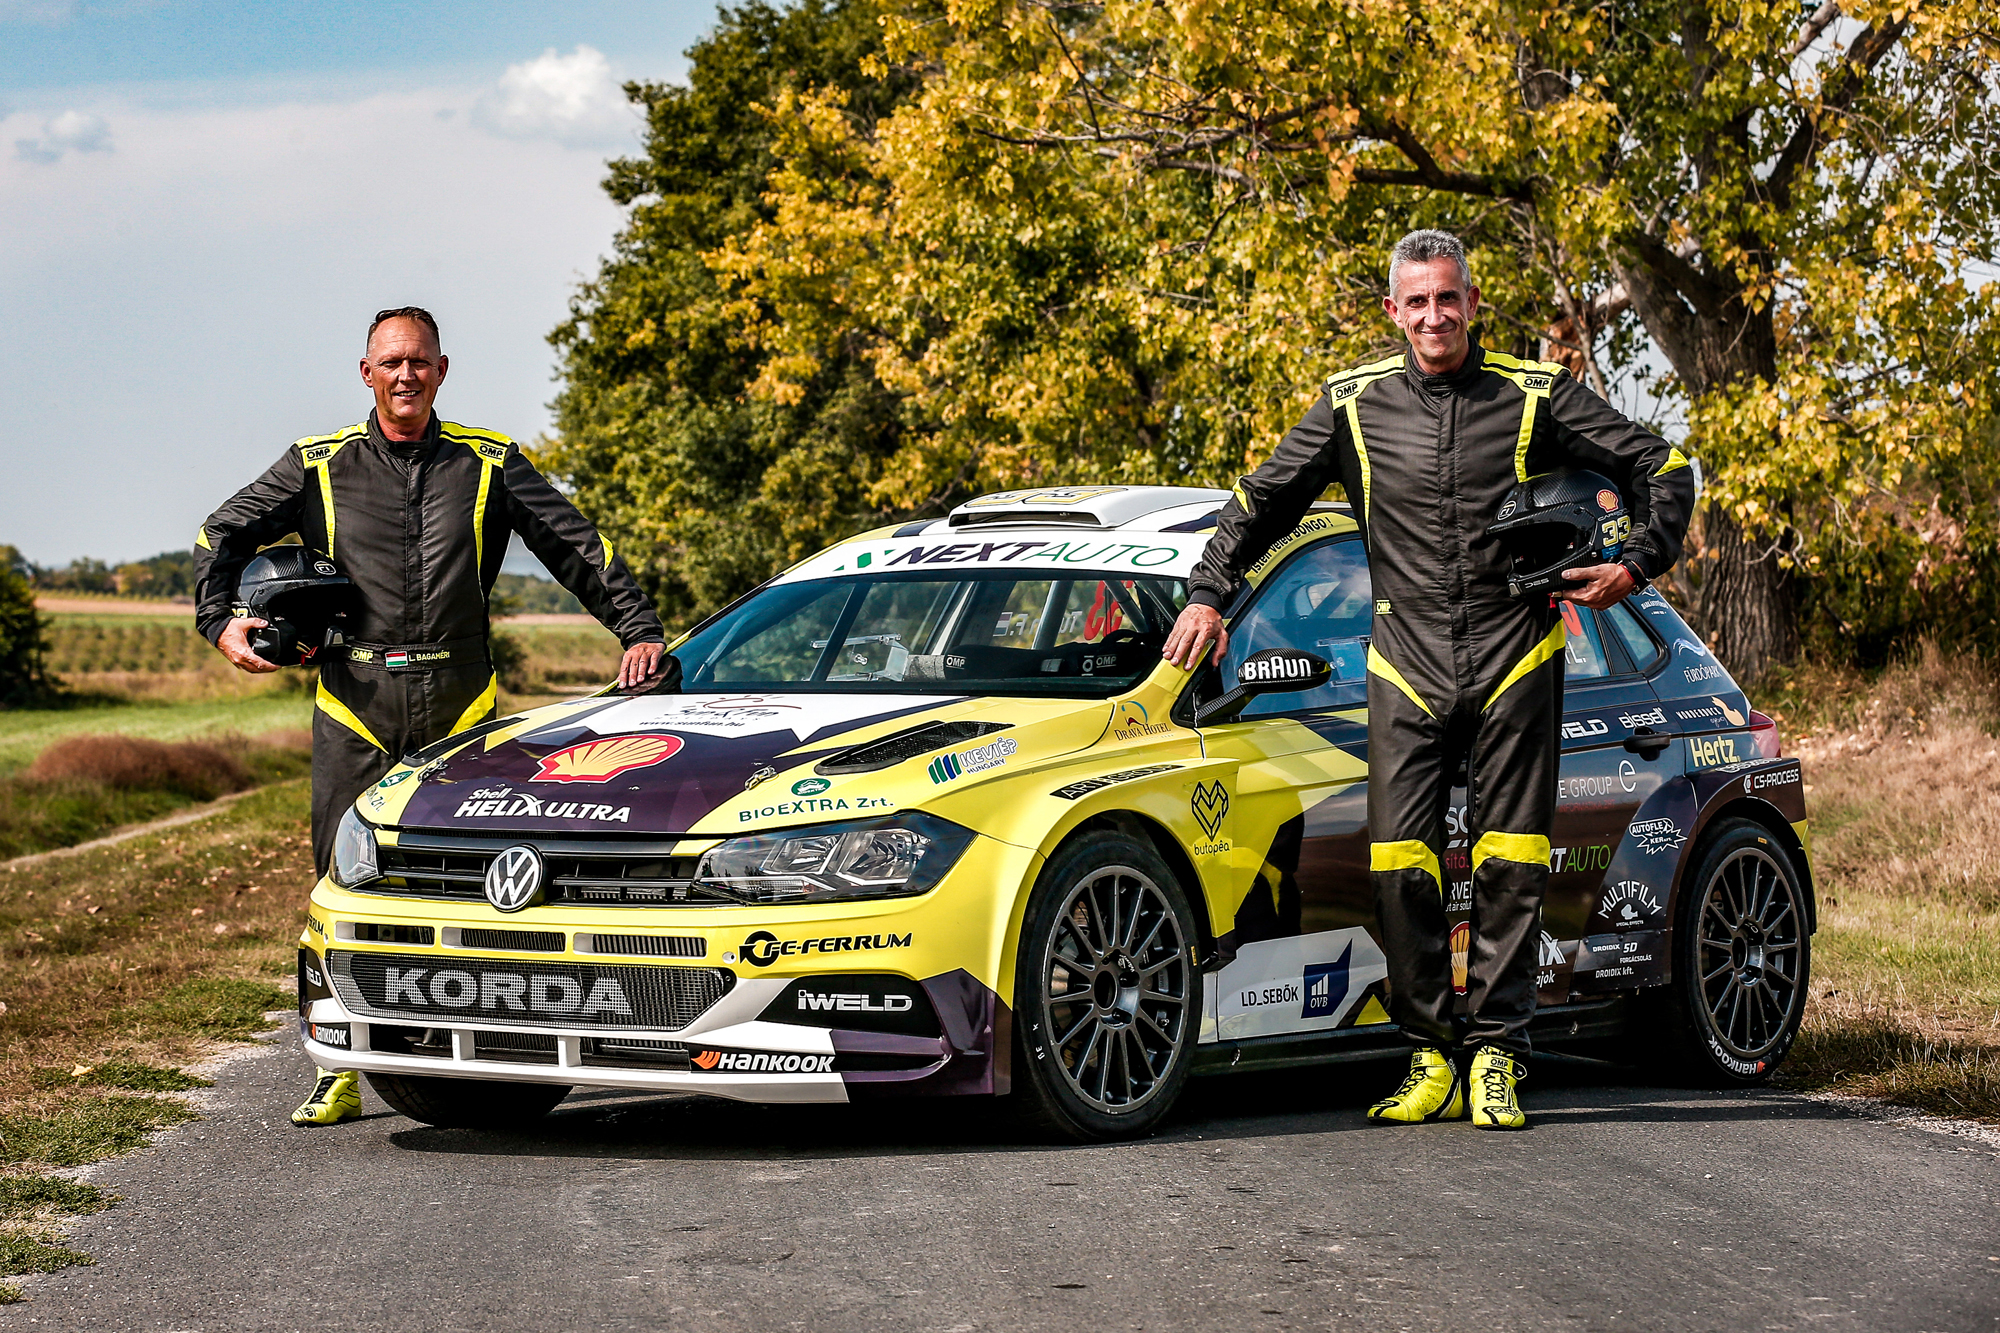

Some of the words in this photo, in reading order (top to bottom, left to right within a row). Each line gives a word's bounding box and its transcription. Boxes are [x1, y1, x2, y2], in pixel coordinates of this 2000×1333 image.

[1523, 378, 1549, 388] OMP
[1335, 383, 1358, 398] OMP
[306, 448, 331, 460] OMP
[479, 445, 504, 457] OMP
[1292, 517, 1327, 539] BONGO
[1601, 514, 1632, 548] 33
[351, 650, 374, 662] OMP
[946, 656, 967, 667] OMP
[1095, 656, 1117, 667] OMP
[1143, 722, 1172, 735] HOTEL
[966, 758, 1006, 774] HUNGARY
[1754, 768, 1799, 789] CS-PROCESS
[469, 787, 513, 801] Shell
[1569, 776, 1612, 798] GROUP
[453, 799, 545, 818] HELIX
[542, 801, 632, 823] ULTRA
[739, 798, 849, 822] BIOEXTRA
[857, 797, 894, 808] Zrt.
[1597, 880, 1663, 919] MULTIFILM
[1592, 944, 1621, 952] DROIDIX
[1623, 942, 1638, 953] 5D
[1595, 968, 1622, 978] DROIDIX
[1622, 966, 1634, 975] kft.
[384, 967, 633, 1015] KORDA
[797, 989, 913, 1012] iWELD
[1310, 996, 1328, 1008] OVB
[1490, 1058, 1508, 1067] OMP
